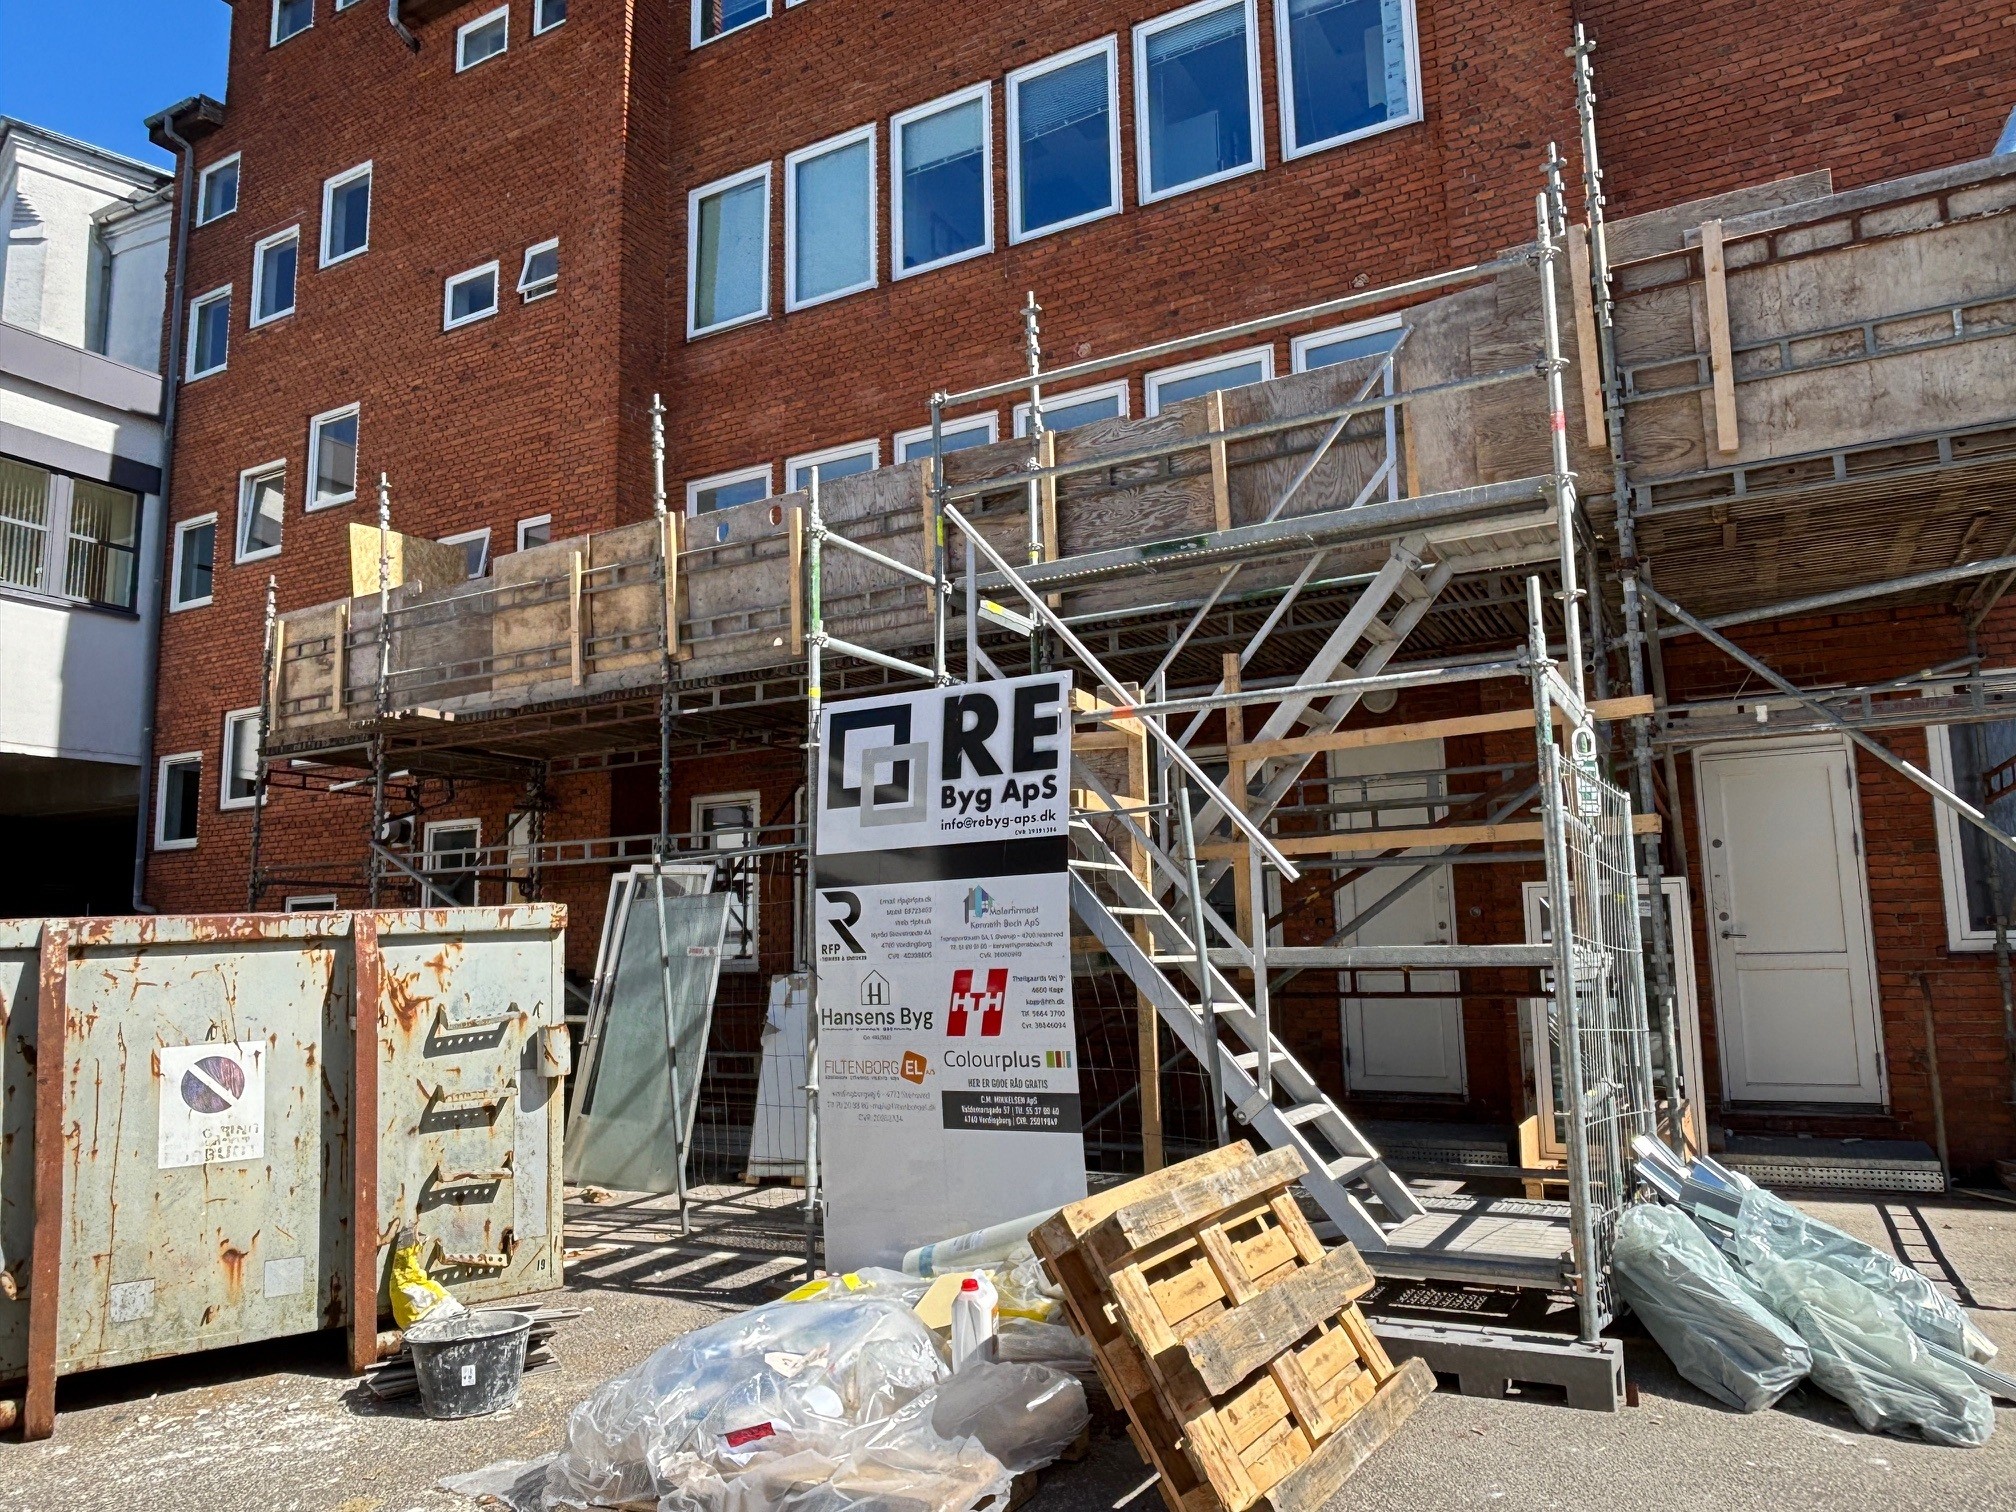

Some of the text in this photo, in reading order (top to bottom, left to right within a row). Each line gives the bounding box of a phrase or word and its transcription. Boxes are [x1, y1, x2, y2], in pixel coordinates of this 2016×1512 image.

[941, 683, 1060, 781] RE
[941, 775, 1058, 815] Byg ApS
[941, 809, 1056, 831] info@rebyg-aps.dk
[821, 943, 841, 955] RFP
[821, 1007, 933, 1030] Hansens Byg
[824, 1060, 899, 1075] FILTENBORG
[905, 1060, 923, 1075] EL
[944, 1050, 1041, 1072] Colourplus
[982, 1079, 990, 1088] ER
[1025, 1079, 1048, 1089] GRATIS
[536, 1258, 546, 1271] 19
